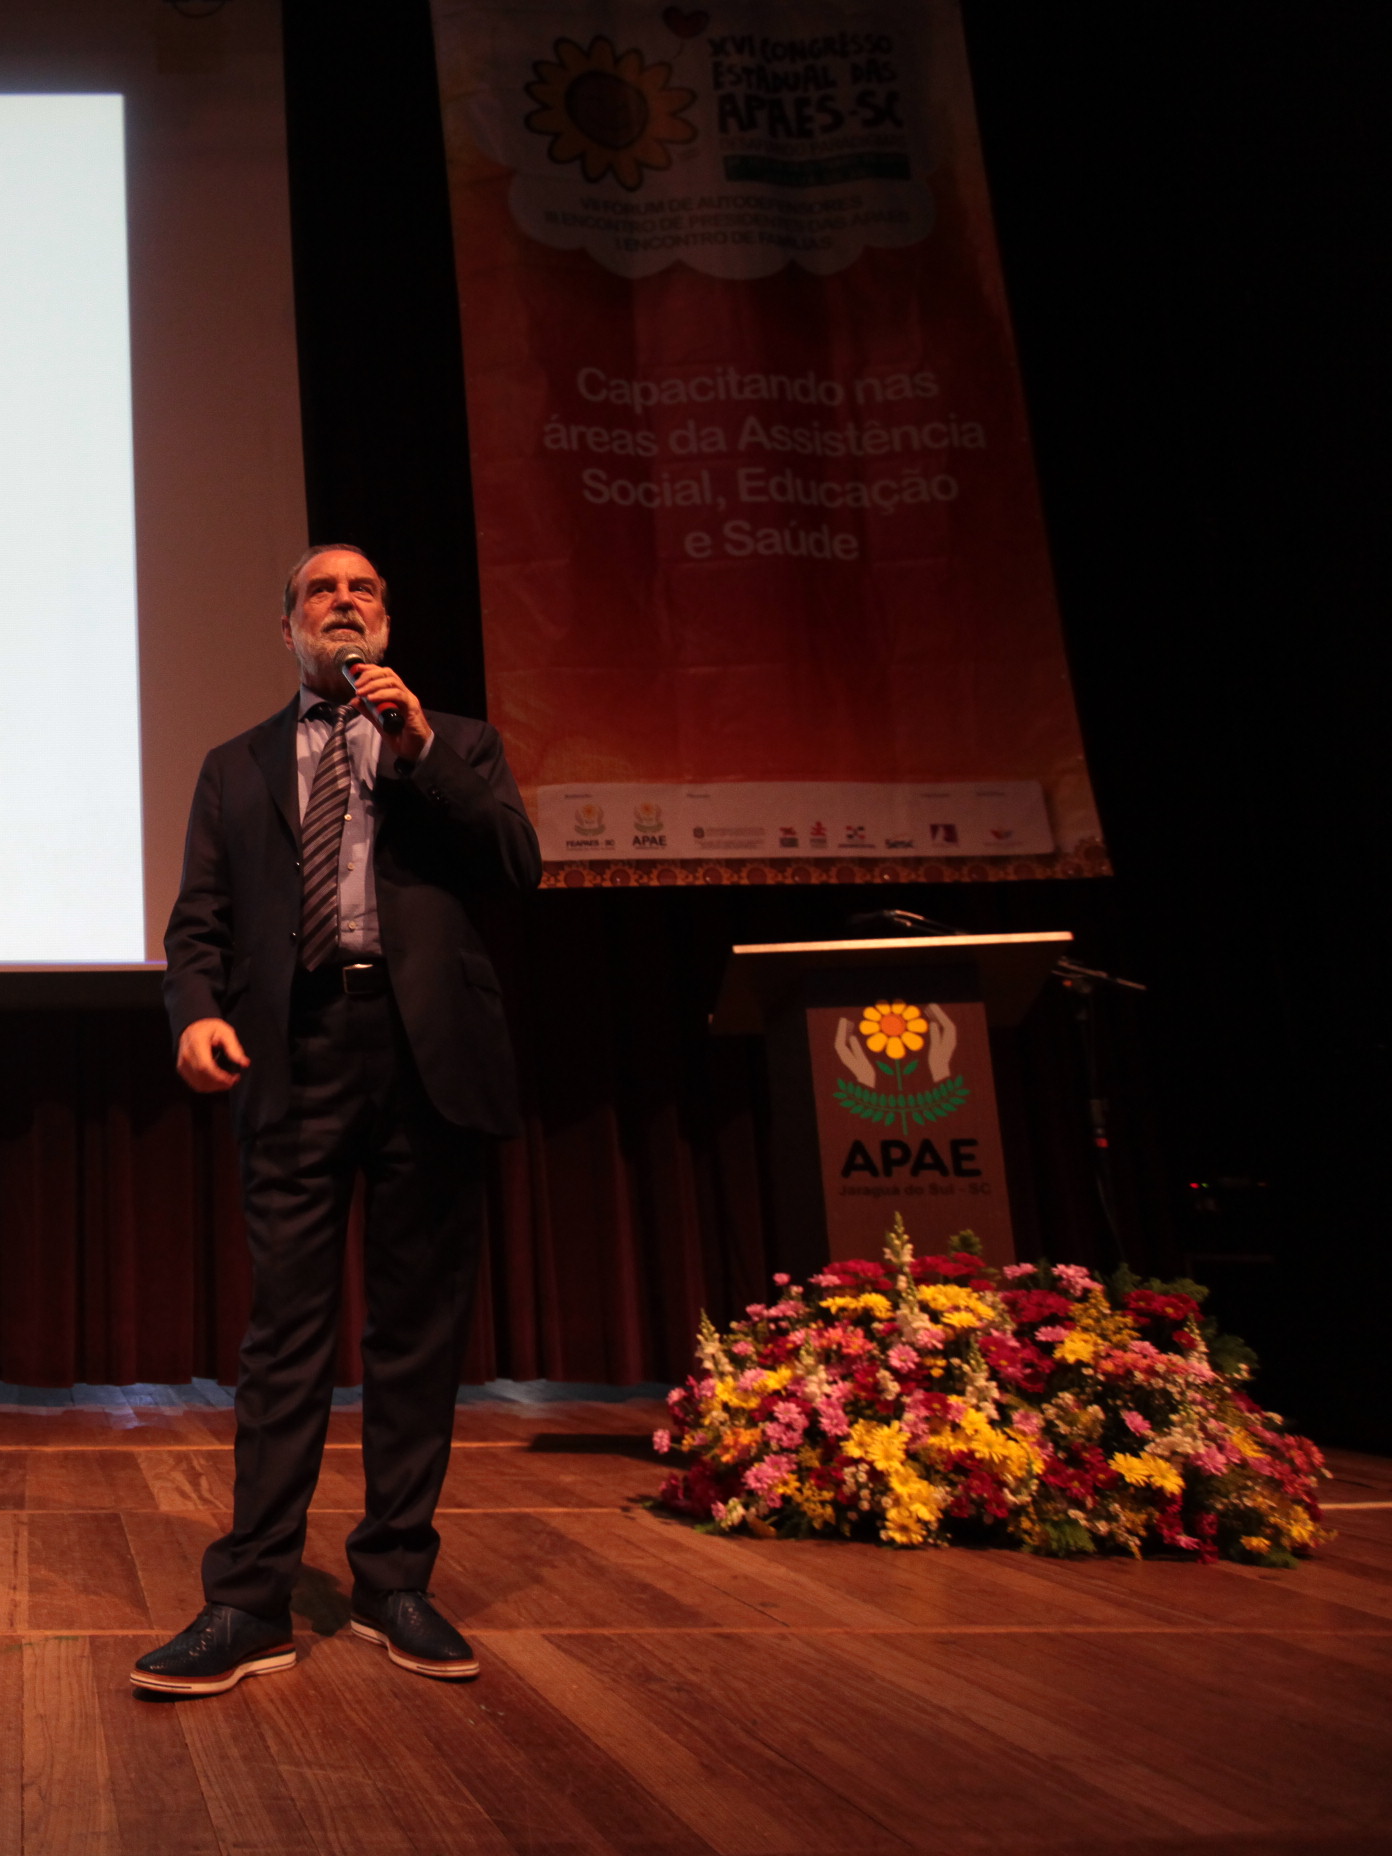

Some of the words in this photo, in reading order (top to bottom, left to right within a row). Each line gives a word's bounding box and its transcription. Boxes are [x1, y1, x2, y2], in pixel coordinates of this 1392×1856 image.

[708, 34, 755, 57] XVI
[760, 31, 893, 64] CONGRESSO
[712, 60, 838, 93] ESTADUAL
[850, 58, 897, 84] DAS
[718, 89, 904, 139] APAES-SC
[561, 211, 656, 233] ENCONTRO
[660, 216, 684, 231] DE
[668, 197, 692, 212] DE
[624, 232, 728, 251] ENCONTRO
[731, 231, 756, 244] DE
[575, 364, 845, 414] Capacitando
[854, 369, 939, 405] nas
[543, 413, 658, 457] áreas
[668, 419, 728, 454] da
[737, 412, 987, 457] Assistência
[581, 467, 727, 510] Social,
[737, 464, 960, 516] Educação
[684, 528, 712, 559] e
[722, 519, 859, 561] Saúde
[632, 835, 668, 847] APAE
[840, 1138, 983, 1179] APAE
[839, 1183, 901, 1199] Jaraguá
[904, 1184, 925, 1196] do
[929, 1182, 955, 1196] Sul
[968, 1182, 992, 1195] SC
